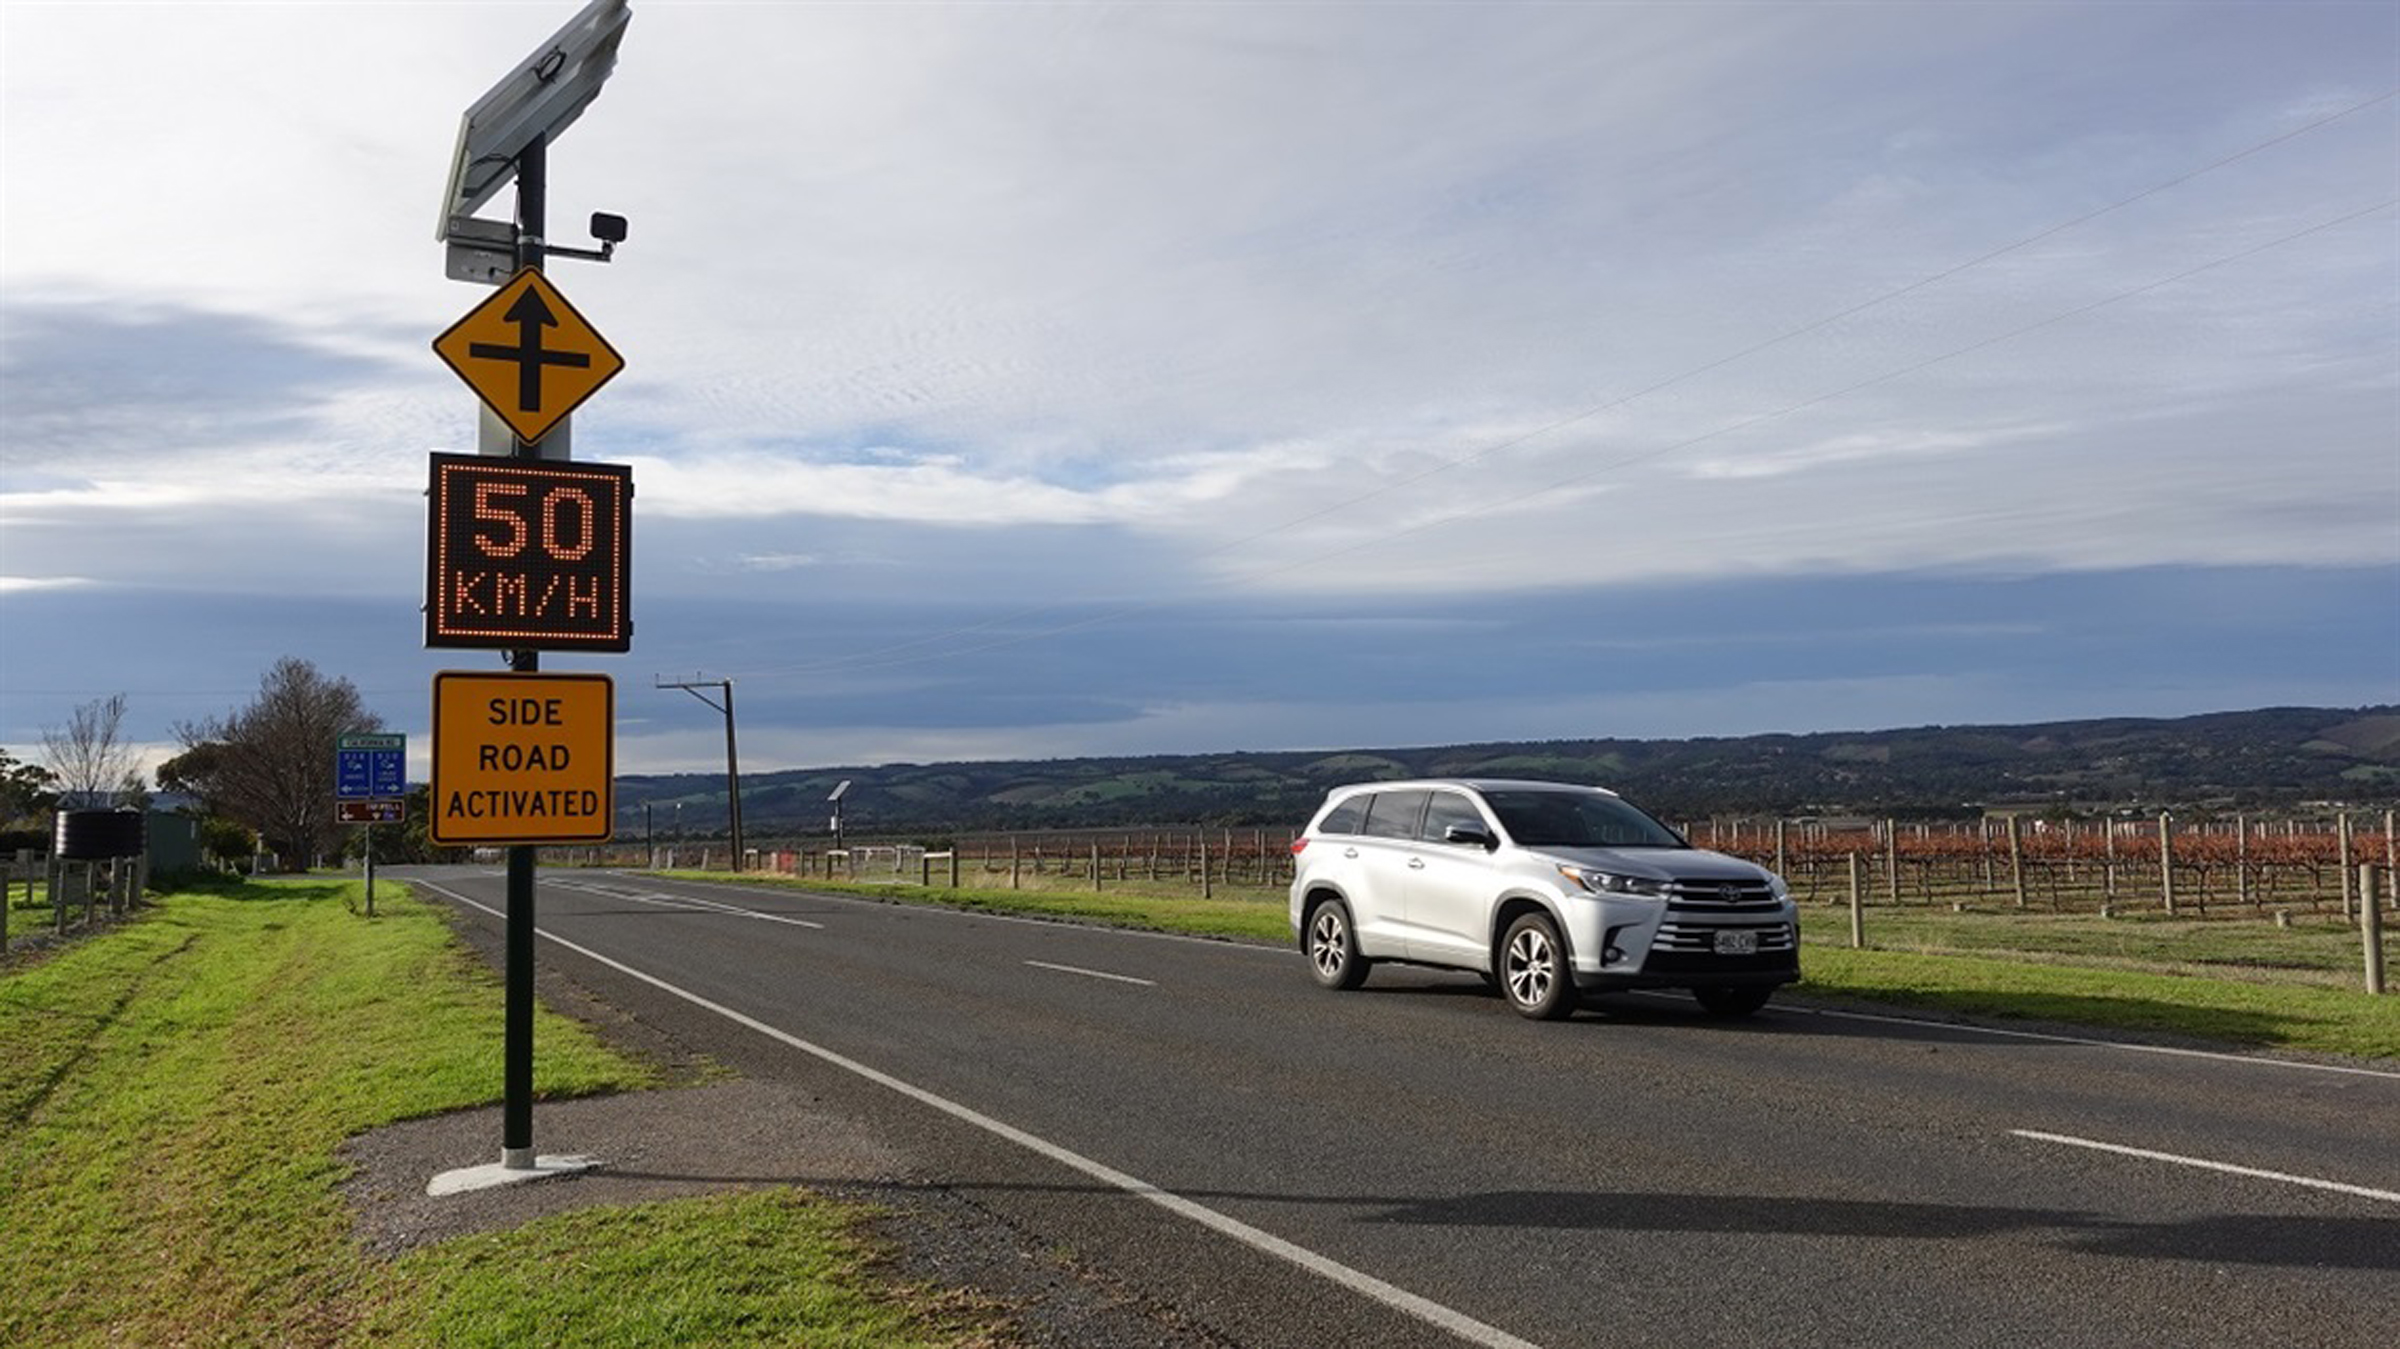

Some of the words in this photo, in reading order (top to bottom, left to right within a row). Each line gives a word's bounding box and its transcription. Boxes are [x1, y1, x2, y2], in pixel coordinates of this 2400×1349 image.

[475, 482, 593, 561] 50
[456, 571, 598, 618] KM/H
[488, 698, 563, 726] SIDE
[479, 744, 570, 772] ROAD
[447, 791, 599, 818] ACTIVATED
